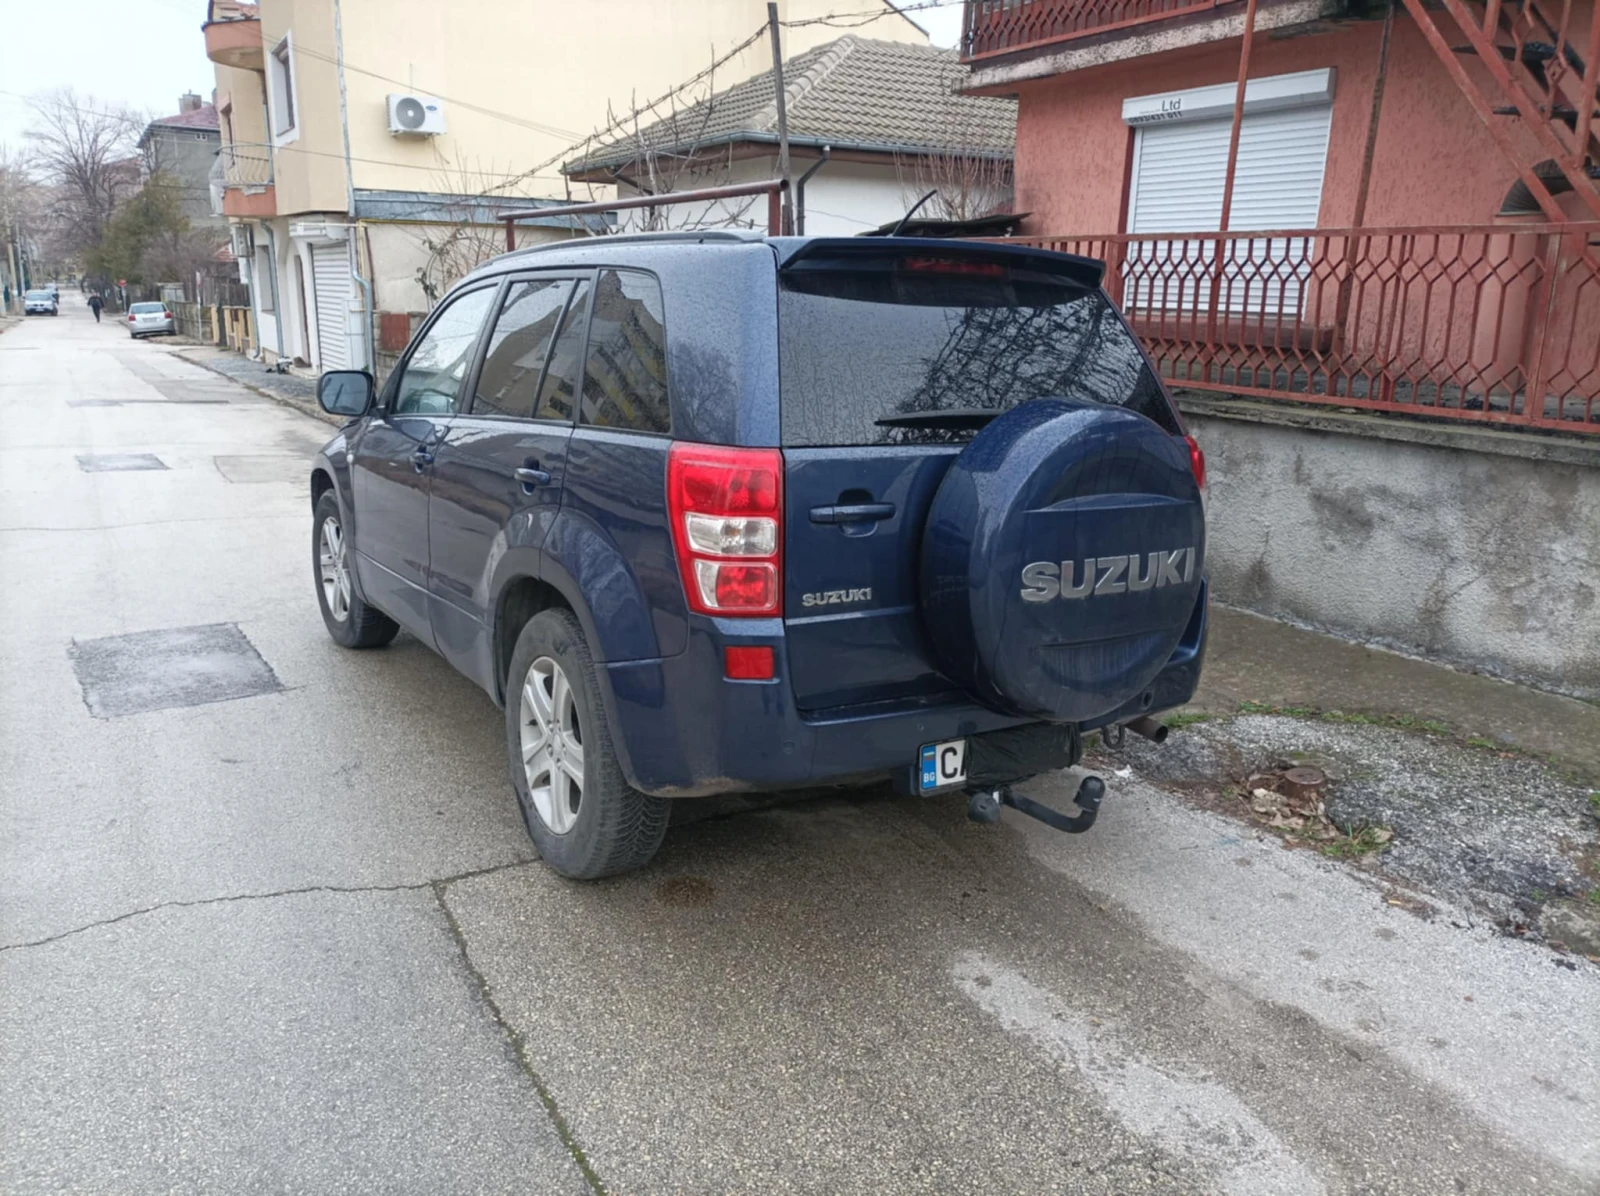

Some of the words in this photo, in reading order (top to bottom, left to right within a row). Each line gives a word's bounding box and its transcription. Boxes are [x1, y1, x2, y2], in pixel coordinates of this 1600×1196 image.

[1162, 98, 1181, 112] Ltd
[1020, 547, 1196, 602] SUZUKI
[802, 587, 872, 607] SUZUKI
[923, 771, 935, 783] BG
